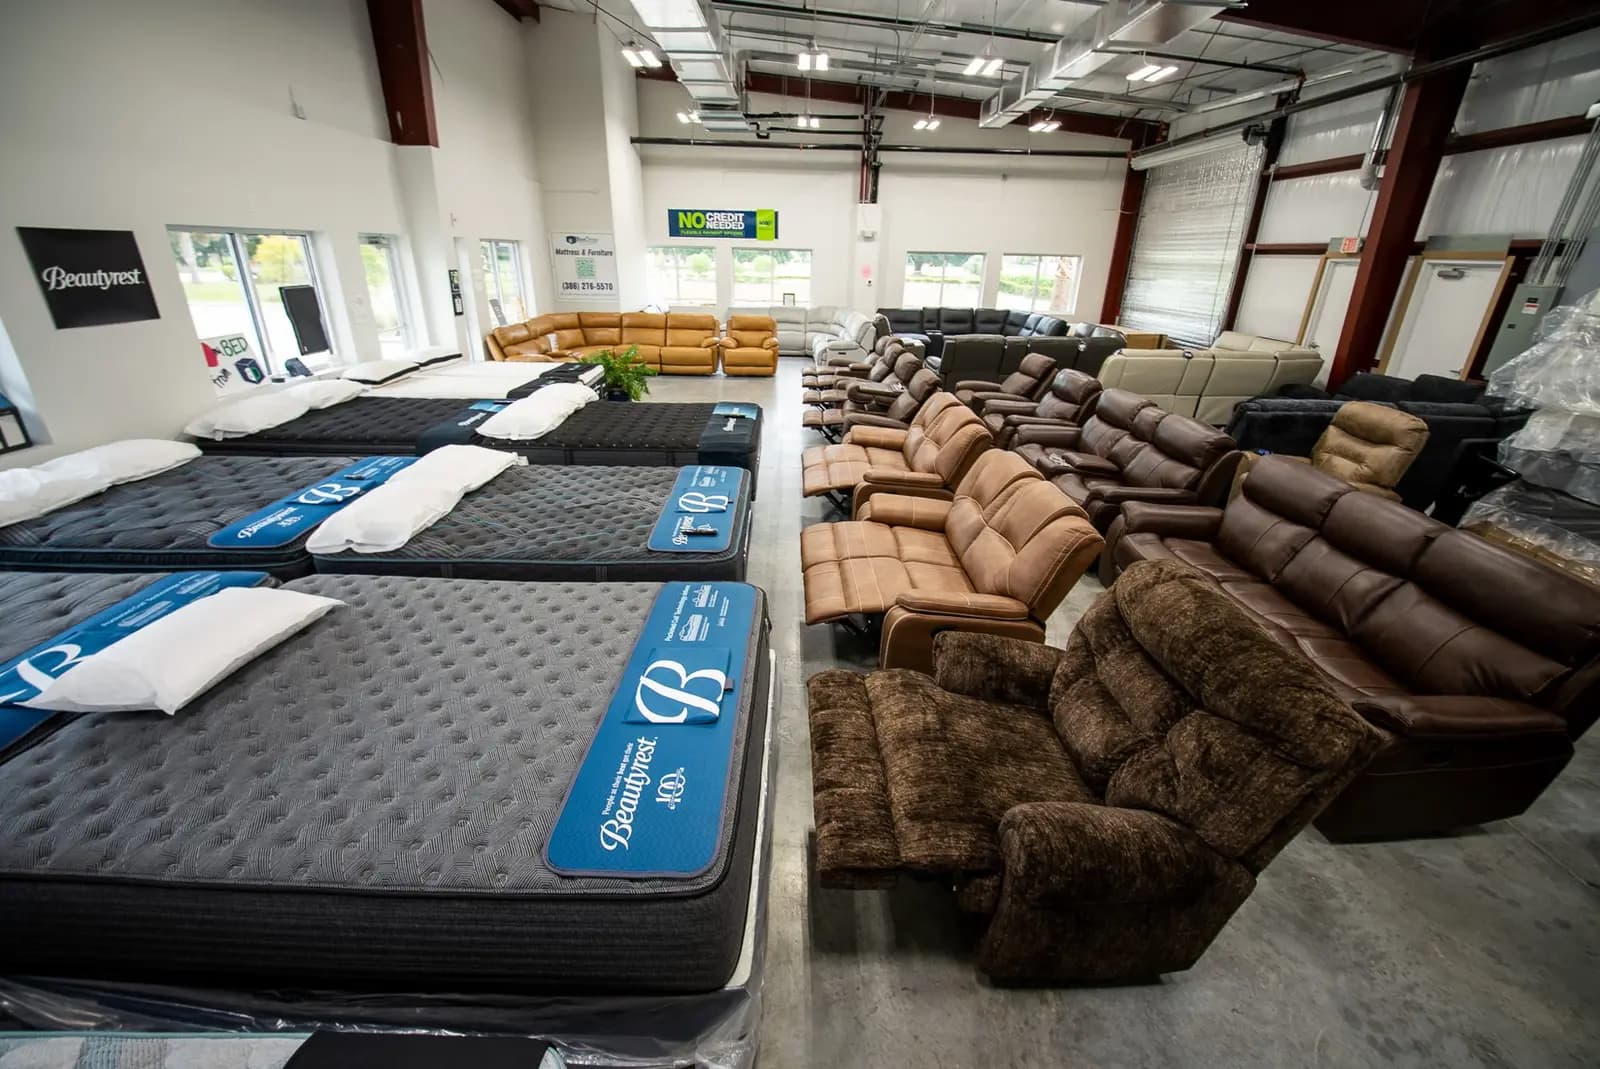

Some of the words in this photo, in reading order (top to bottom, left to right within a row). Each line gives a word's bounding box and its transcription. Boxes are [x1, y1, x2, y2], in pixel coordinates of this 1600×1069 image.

[678, 212, 706, 229] NO
[705, 212, 745, 222] CREDIT
[706, 221, 745, 230] NEEDED
[555, 248, 580, 256] Mattress
[587, 249, 613, 257] Furniture
[42, 265, 141, 291] Beautyrest
[219, 336, 249, 357] BED
[635, 659, 727, 724] B
[601, 795, 615, 815] People
[616, 763, 627, 775] best
